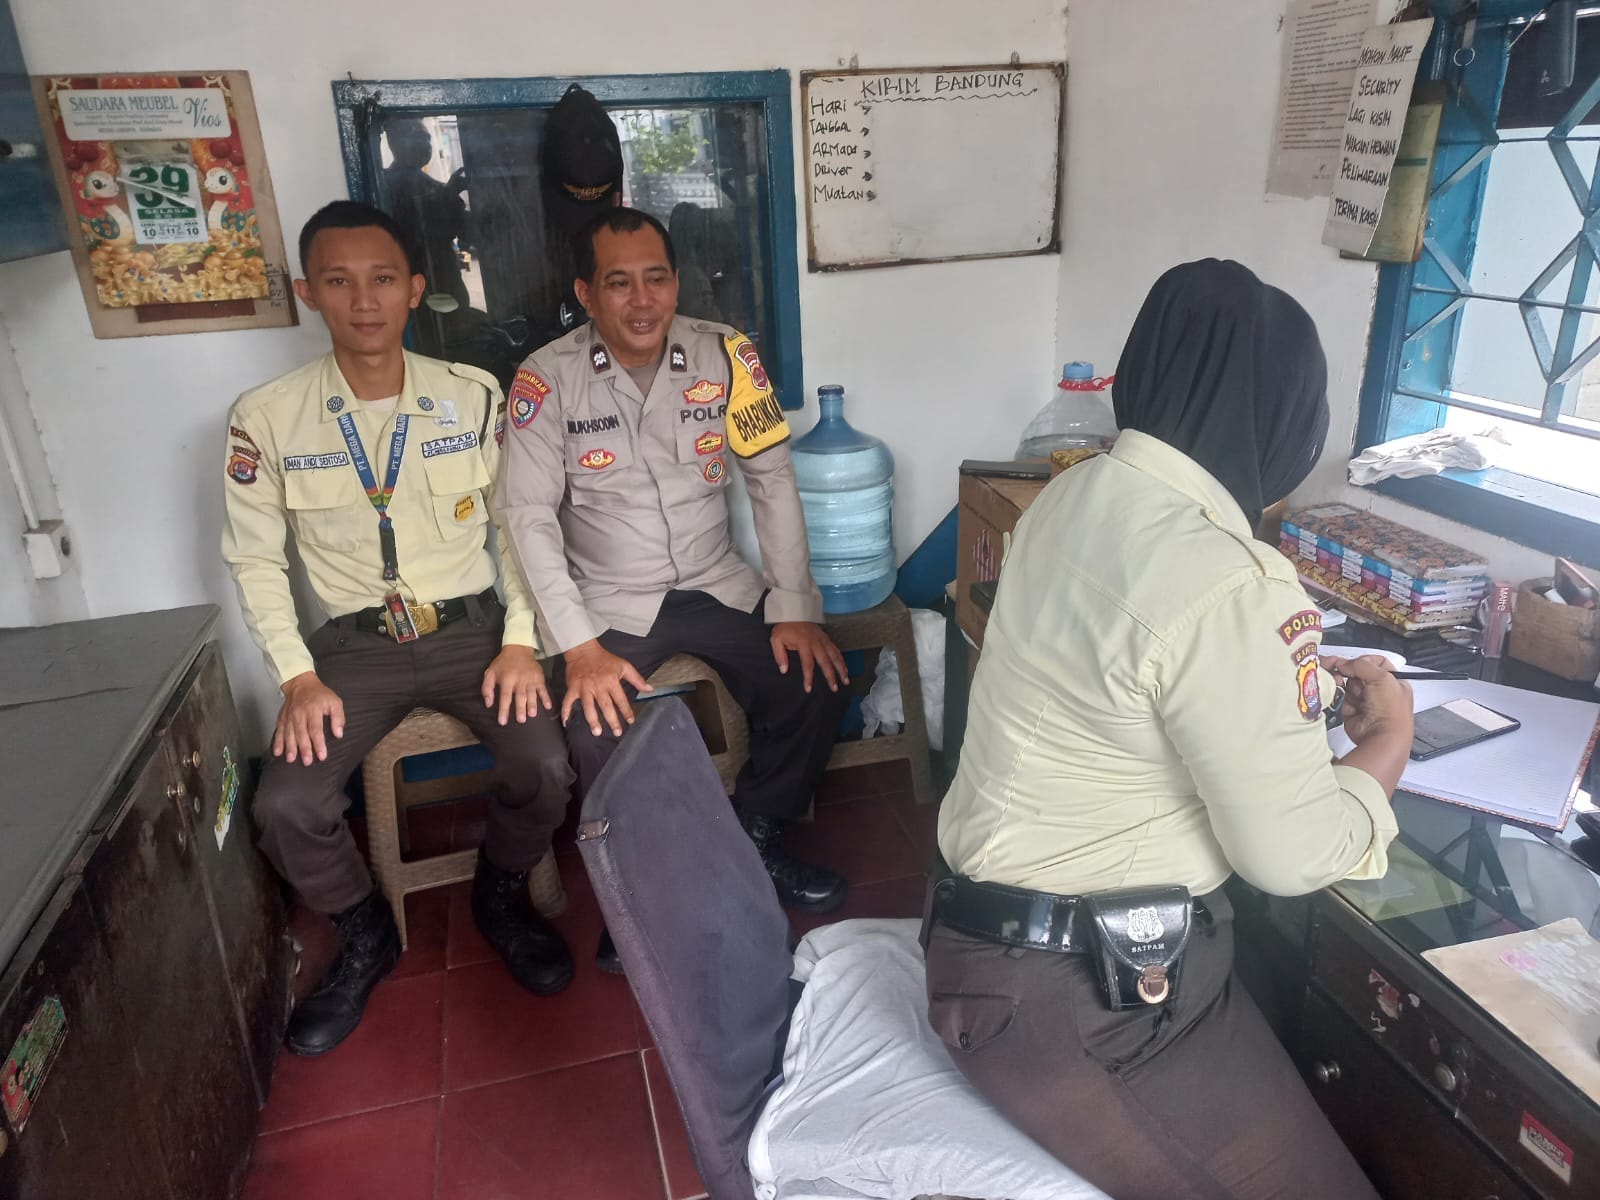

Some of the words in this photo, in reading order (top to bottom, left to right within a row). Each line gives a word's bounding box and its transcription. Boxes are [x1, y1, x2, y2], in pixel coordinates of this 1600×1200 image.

[861, 77, 920, 98] KIRIM
[935, 73, 1024, 94] BANDUNG
[1358, 74, 1402, 97] SECURITY
[69, 97, 127, 112] SAUDARA
[129, 95, 179, 111] MEUBEL
[183, 98, 223, 128] Vios
[142, 229, 157, 237] 10
[186, 227, 199, 236] 10
[425, 433, 474, 449] SATPAM
[1284, 614, 1320, 640] POLDA
[1131, 943, 1165, 953] SATPAM
